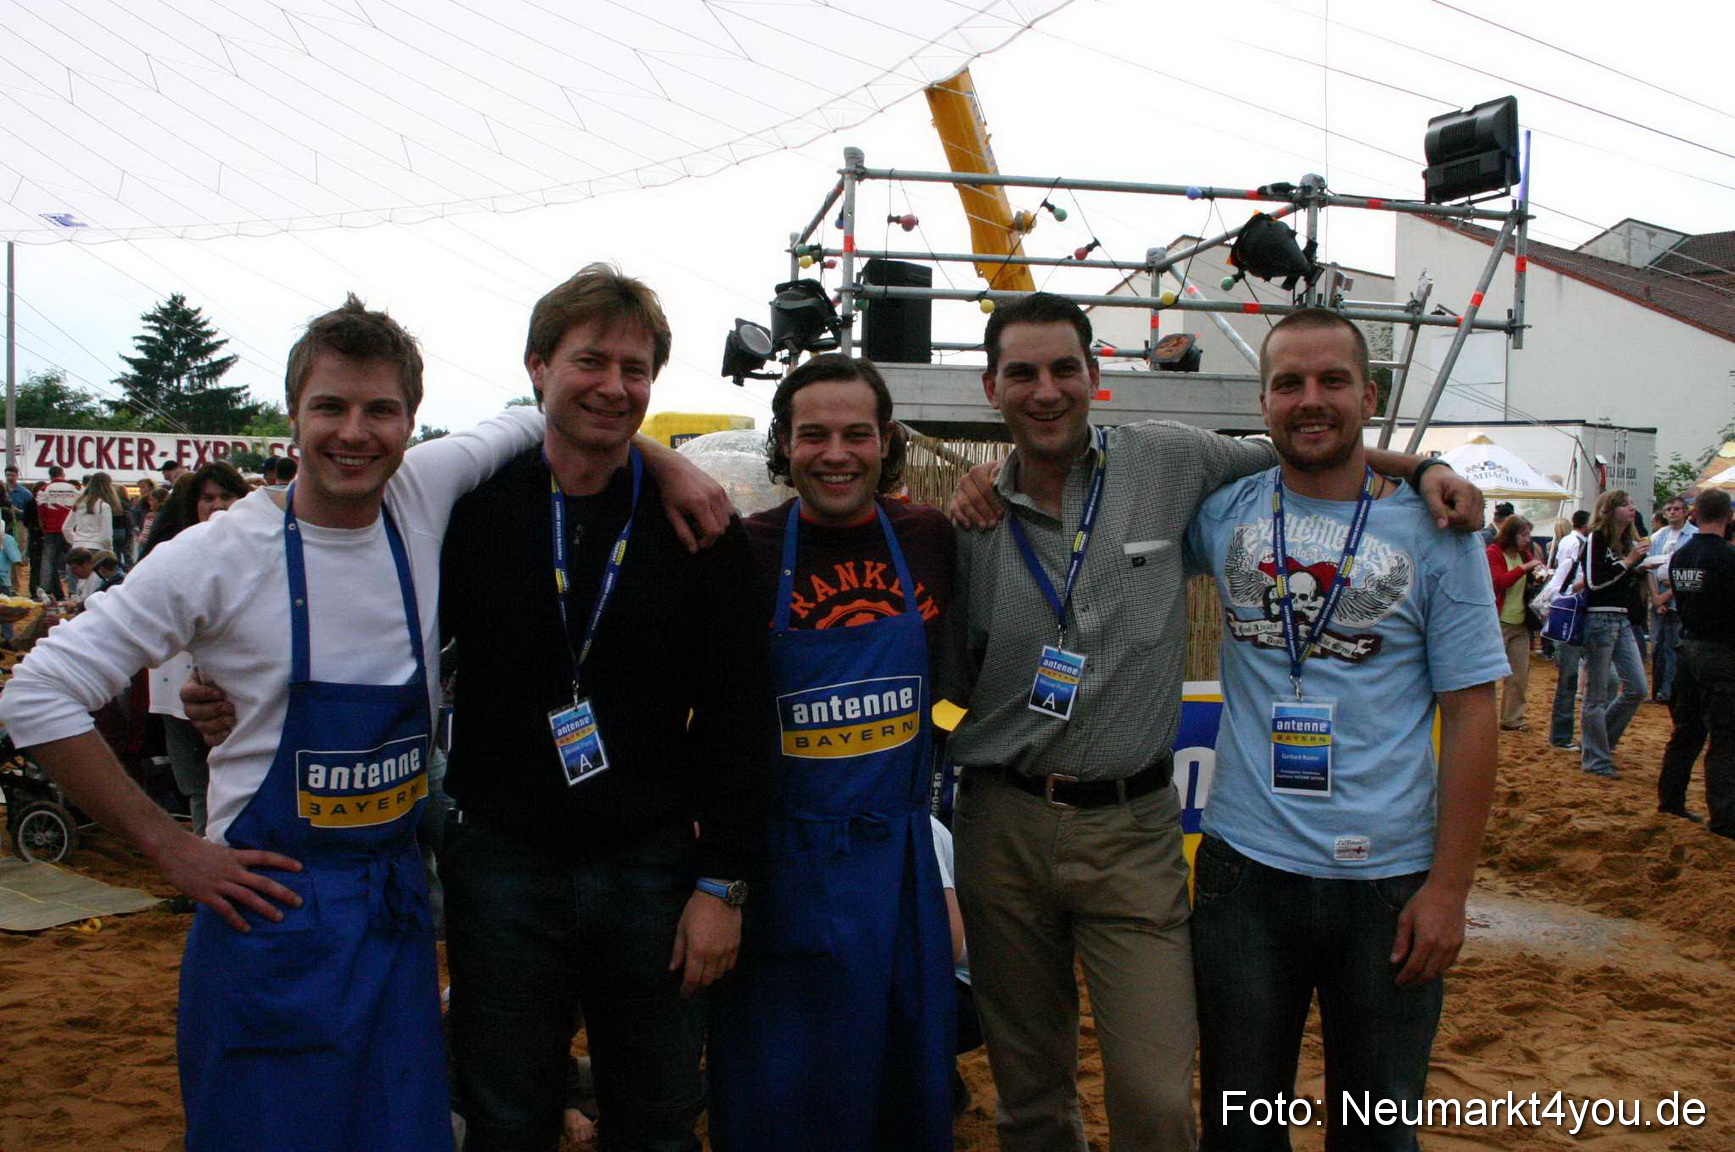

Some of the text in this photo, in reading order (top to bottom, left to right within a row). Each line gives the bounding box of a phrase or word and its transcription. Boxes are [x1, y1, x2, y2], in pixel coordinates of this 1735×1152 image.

[792, 687, 913, 724] antenne
[1042, 692, 1056, 710] A
[795, 720, 914, 748] BAYERN
[1276, 719, 1328, 732] antenne
[307, 747, 420, 790] antenne
[580, 753, 593, 773] A
[309, 785, 420, 816] BAYERN
